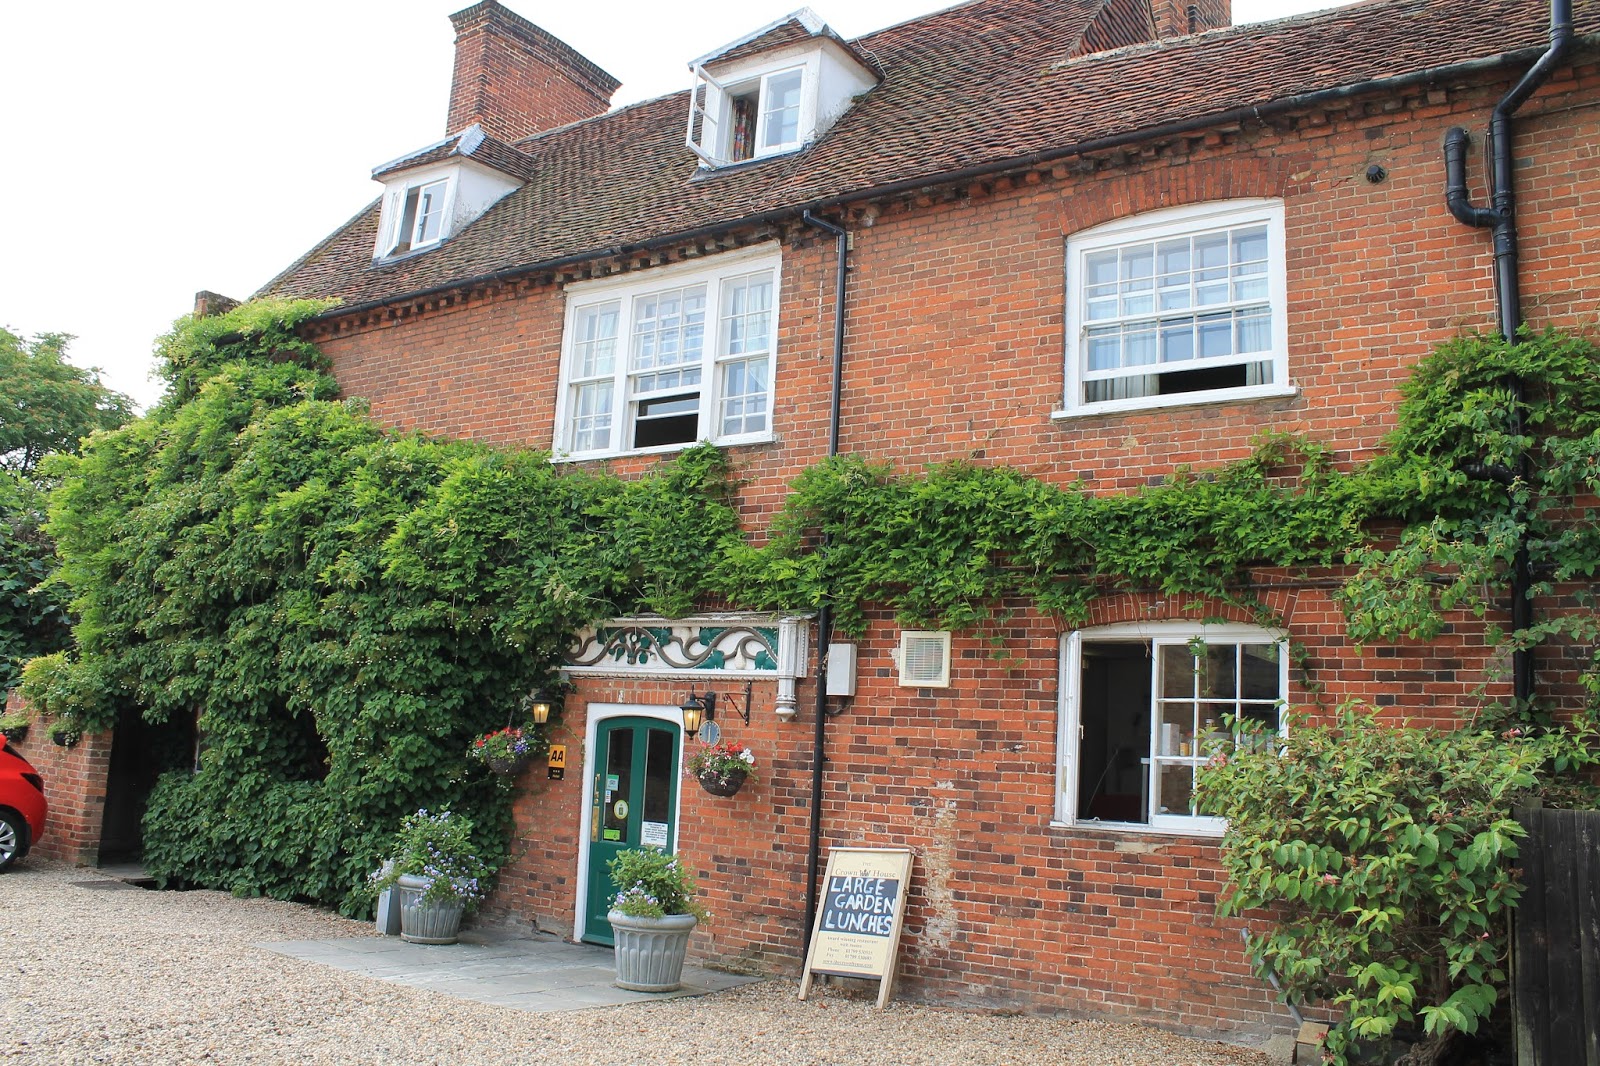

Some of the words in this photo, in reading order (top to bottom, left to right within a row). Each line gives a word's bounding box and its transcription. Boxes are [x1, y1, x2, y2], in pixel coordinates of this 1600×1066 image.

[550, 750, 563, 762] AA
[835, 868, 858, 876] Crown
[873, 870, 896, 878] House
[830, 876, 886, 896] LARGE
[834, 894, 896, 914] GARDEN
[825, 909, 893, 935] LUNCHES
